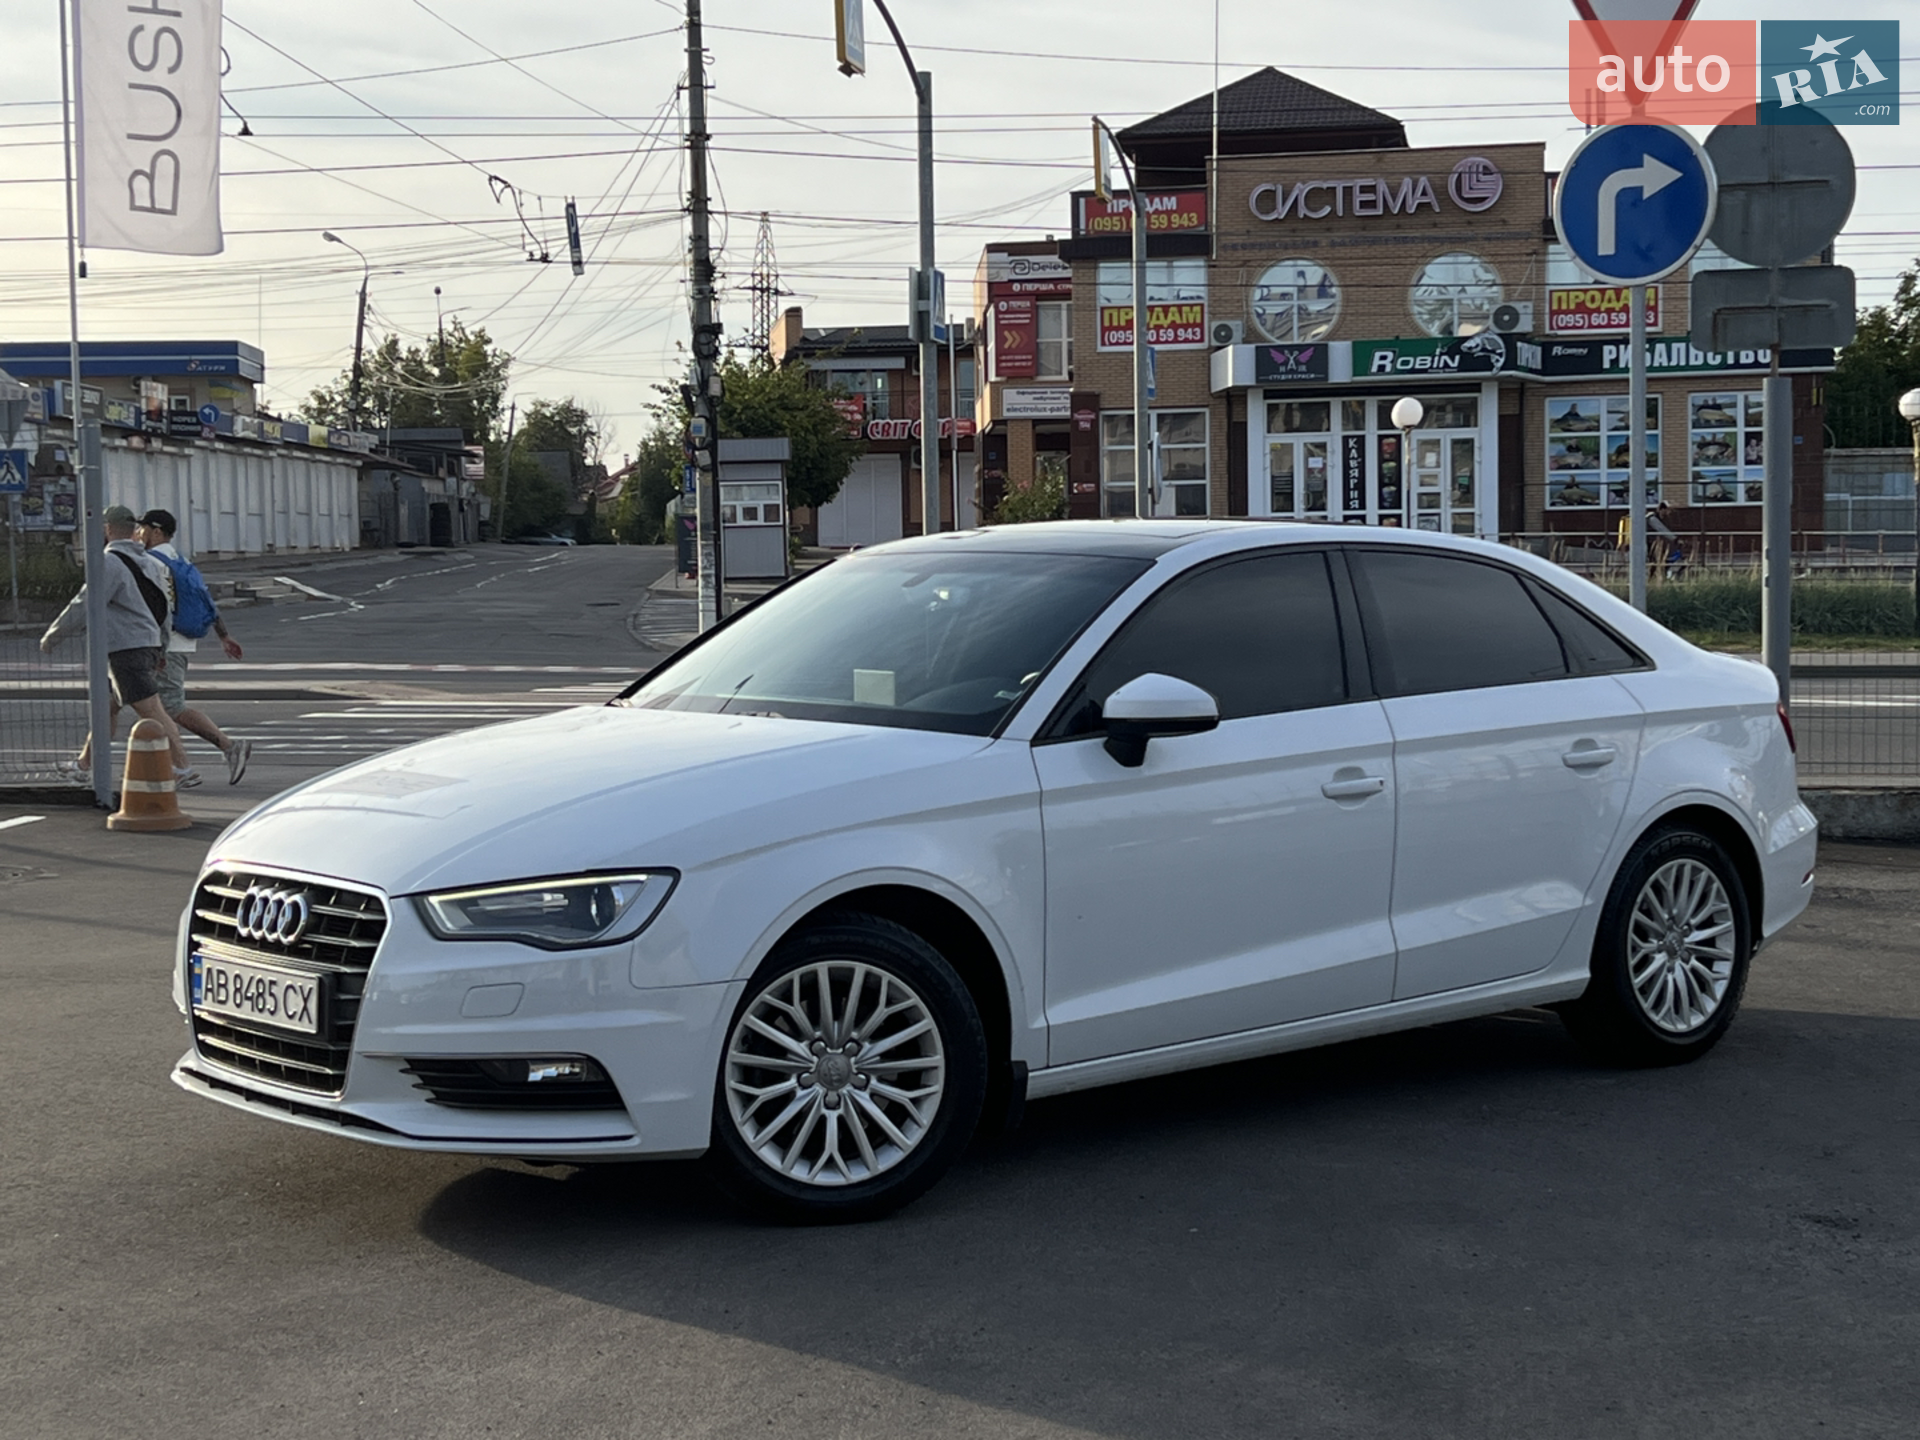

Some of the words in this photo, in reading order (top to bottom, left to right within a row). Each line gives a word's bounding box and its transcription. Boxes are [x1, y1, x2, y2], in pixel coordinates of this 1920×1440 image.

[1249, 176, 1440, 221] СИСТЕМА
[1088, 216, 1127, 232] (095)
[1151, 214, 1168, 228] 59
[1171, 212, 1198, 228] 943
[1103, 305, 1202, 328] ПРДАМ
[1552, 314, 1589, 330] (095)
[1591, 313, 1608, 326] 60
[1610, 312, 1627, 325] 59
[1104, 331, 1133, 346] (095
[1159, 329, 1175, 342] 59
[1176, 327, 1201, 341] 943
[867, 419, 912, 440] СВІТ
[204, 964, 229, 1005] AB
[233, 971, 278, 1016] 8485
[283, 982, 314, 1024] CX
